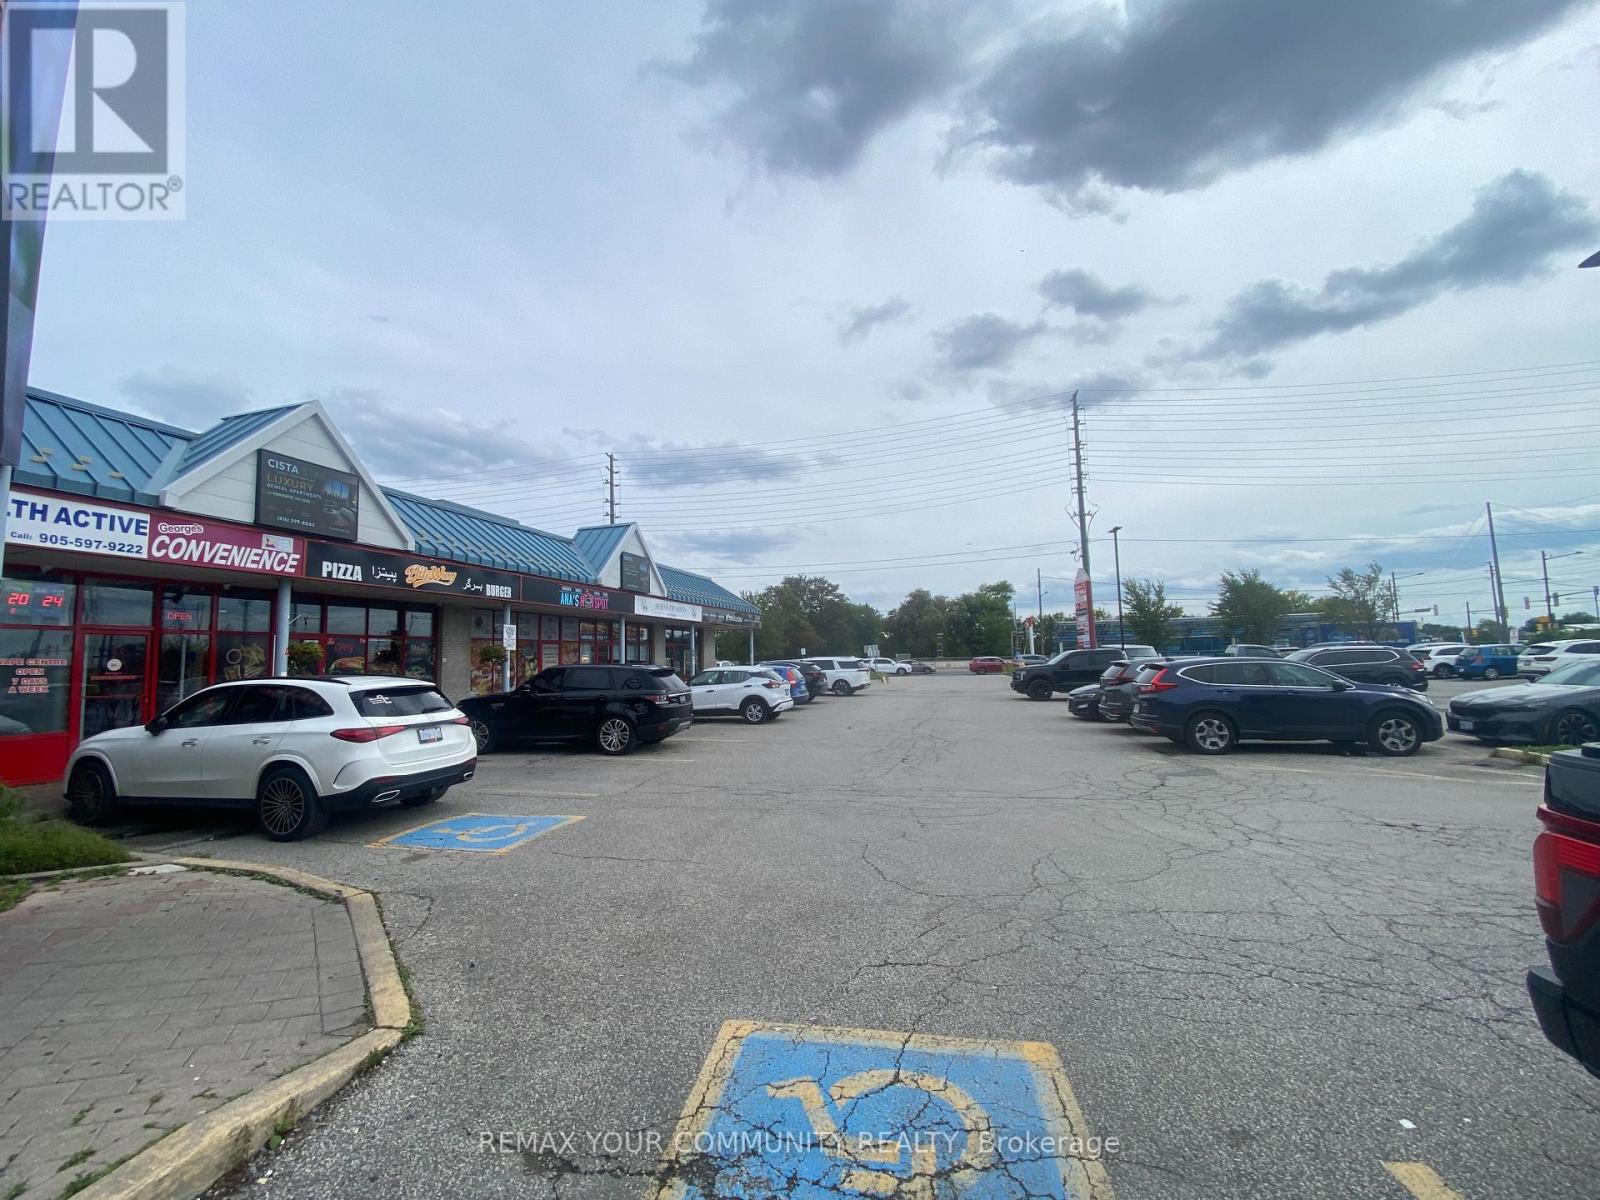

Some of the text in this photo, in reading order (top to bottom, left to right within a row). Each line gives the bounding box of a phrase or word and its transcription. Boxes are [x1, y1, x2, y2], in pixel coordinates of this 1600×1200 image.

[267, 458, 299, 475] CISTA
[267, 472, 314, 492] LUXURY
[7, 499, 148, 536] TH ACTIVE
[10, 531, 143, 555] Call: 905-597-9222
[151, 535, 301, 573] CONVENIENCE
[321, 561, 363, 582] PIZZA
[485, 583, 512, 598] BURGER
[8, 592, 64, 608] 20 24
[167, 611, 193, 621] OPEN
[15, 667, 45, 676] OPEN
[8, 685, 50, 694] A WEEK
[11, 677, 48, 686] 7 DAYS
